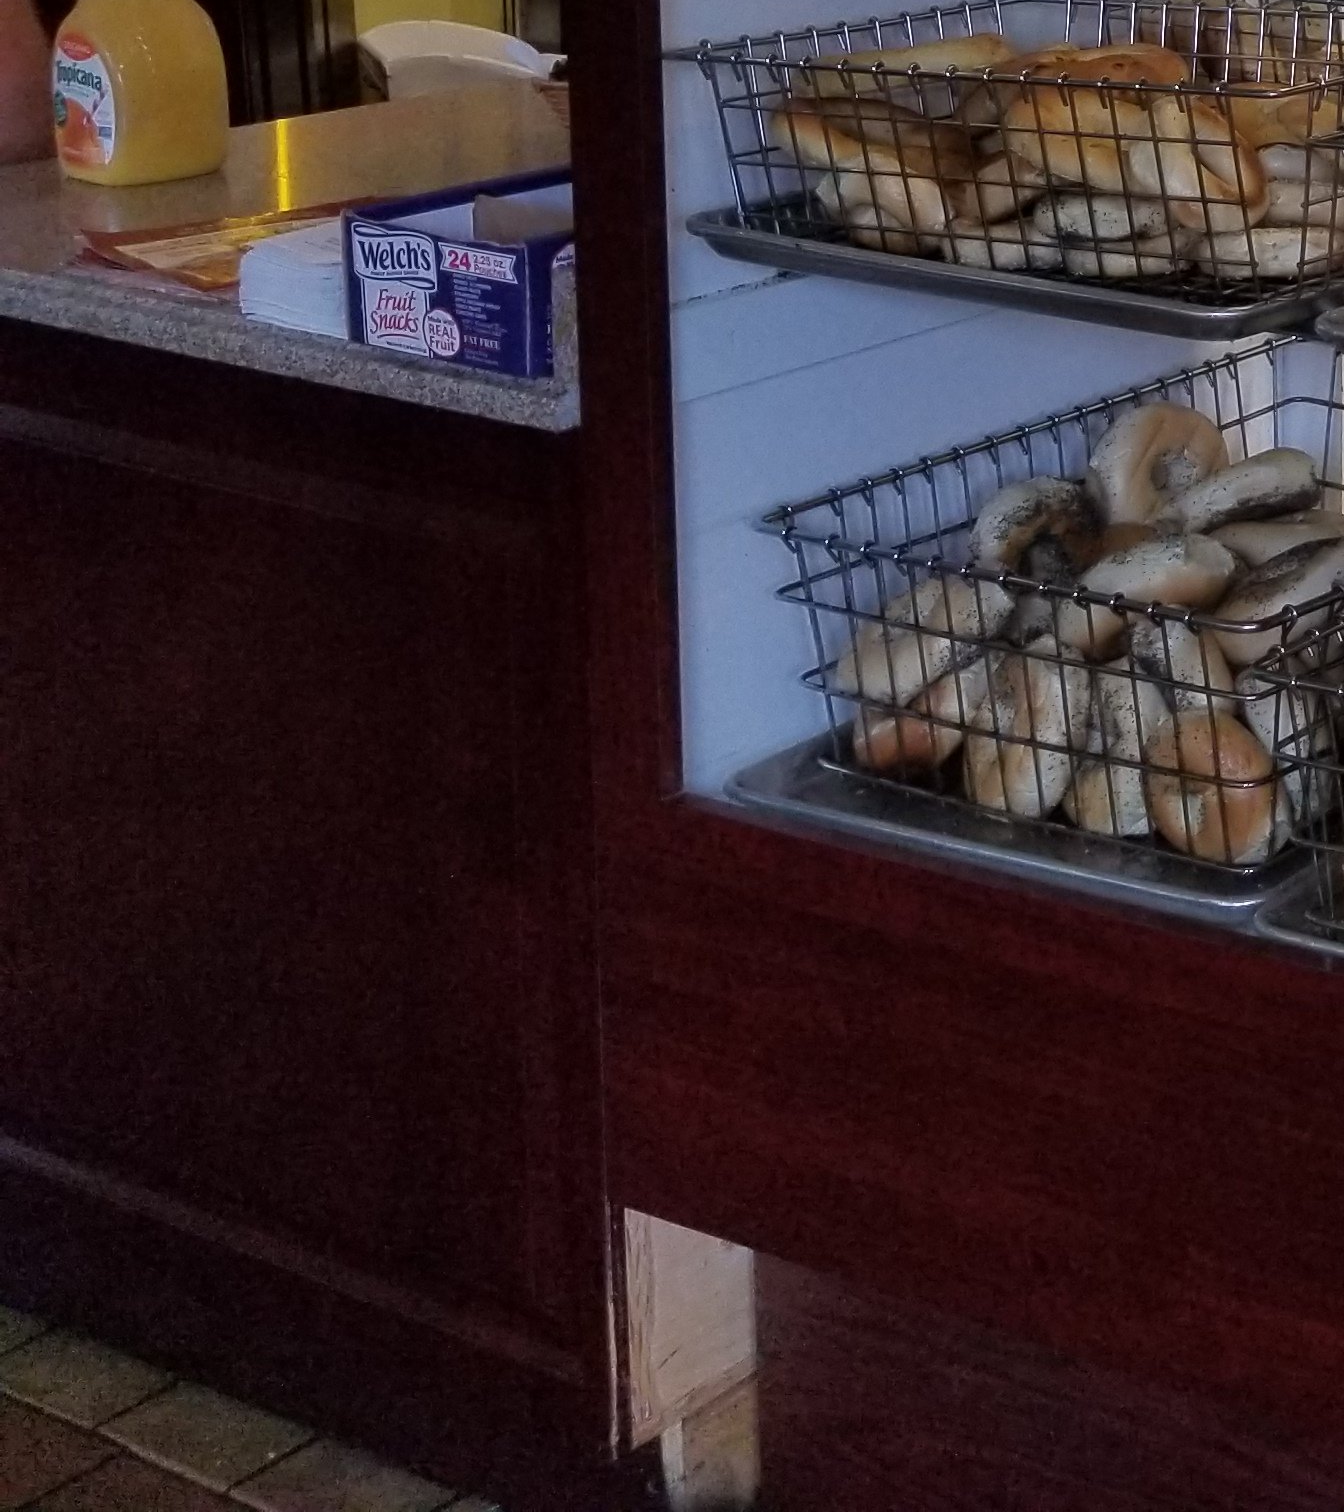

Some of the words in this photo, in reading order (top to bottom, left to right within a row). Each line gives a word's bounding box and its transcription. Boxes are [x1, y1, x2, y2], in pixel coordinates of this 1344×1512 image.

[357, 240, 431, 271] Welch's
[448, 250, 471, 271] 24
[376, 289, 417, 311] Fruit
[370, 310, 419, 334] Snacks
[429, 324, 457, 340] REAL
[429, 338, 455, 352] Fruit
